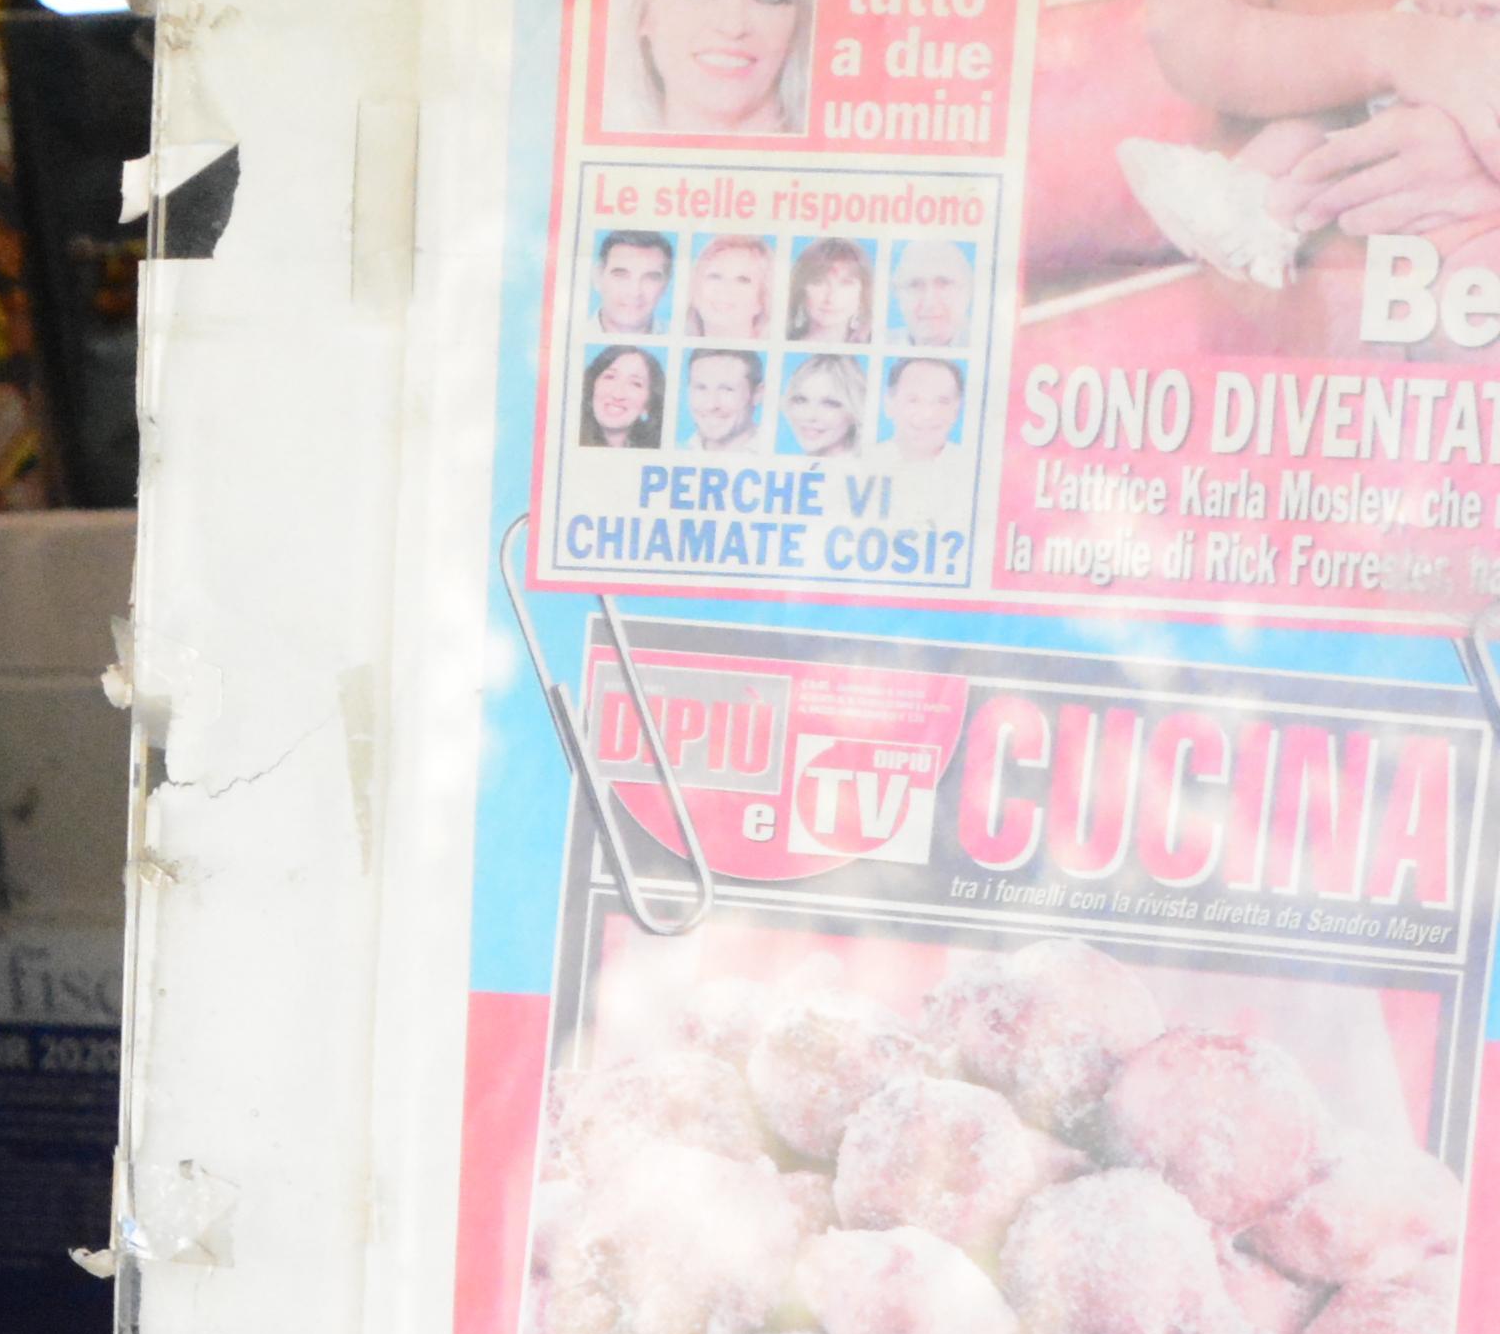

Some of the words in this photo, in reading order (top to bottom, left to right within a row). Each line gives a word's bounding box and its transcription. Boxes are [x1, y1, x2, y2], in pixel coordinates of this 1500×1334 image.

[831, 42, 863, 77] a
[886, 28, 995, 81] due
[822, 90, 992, 145] uomini
[593, 173, 641, 218] Le
[653, 175, 758, 222] stelle
[770, 181, 986, 234] rispondono
[1020, 362, 1193, 455] SONO
[638, 460, 825, 516] PERCHÉ
[843, 473, 892, 520] VI
[1034, 458, 1168, 517] L'attrice
[1179, 466, 1267, 521] Karla
[1278, 470, 1408, 533] Mosley,
[1422, 476, 1482, 526] che
[598, 686, 782, 777] DIPIÙ
[741, 794, 776, 843] e
[805, 764, 910, 841] TV
[957, 695, 1452, 909] CUCINA
[950, 877, 978, 900] tra
[994, 878, 1067, 909] fornelli
[1069, 889, 1106, 911] con
[1110, 889, 1131, 913] la
[1134, 891, 1197, 921] rivista
[1204, 896, 1268, 925] diretta
[1275, 905, 1299, 928] da
[1306, 906, 1381, 939] Sandro
[1387, 914, 1454, 947] Mayer
